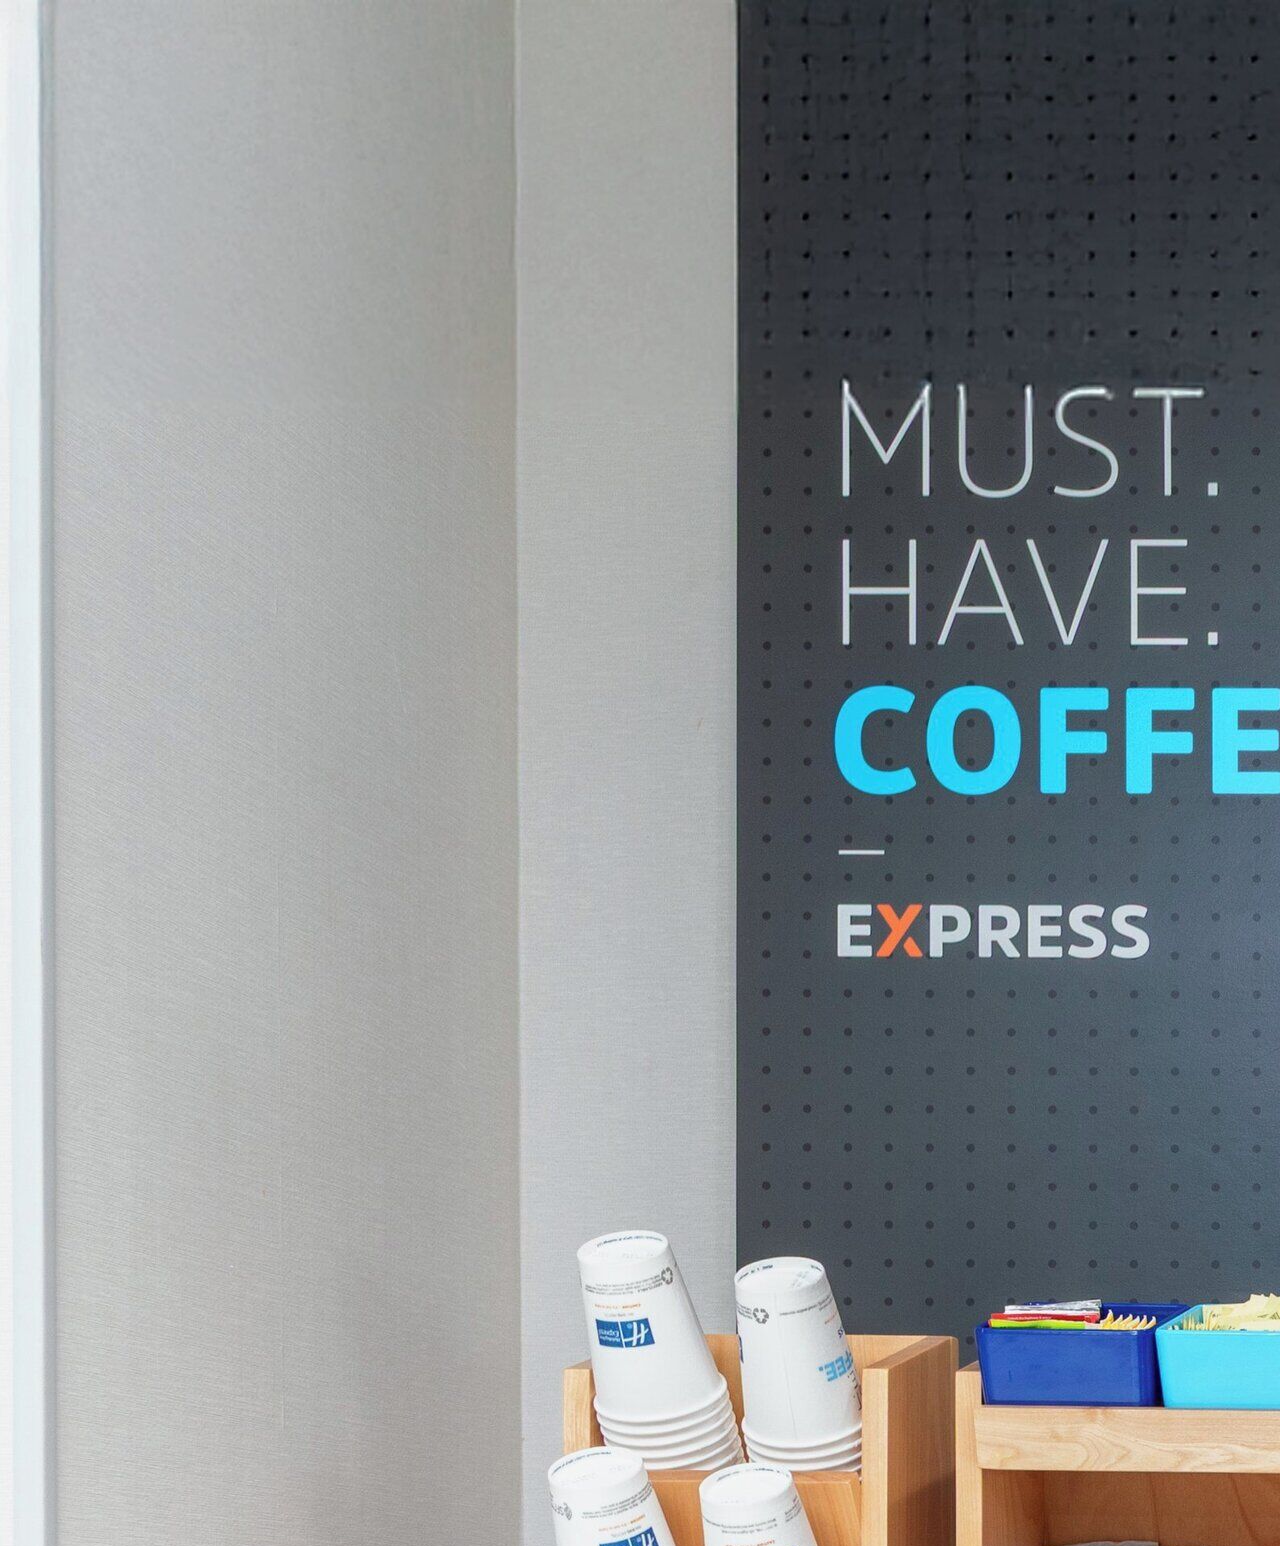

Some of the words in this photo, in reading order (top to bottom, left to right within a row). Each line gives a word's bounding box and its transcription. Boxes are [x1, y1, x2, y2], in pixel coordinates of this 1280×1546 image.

[842, 379, 1219, 498] MUST.
[842, 539, 1219, 646] HAVE.
[836, 904, 1151, 959] EXPRESS
